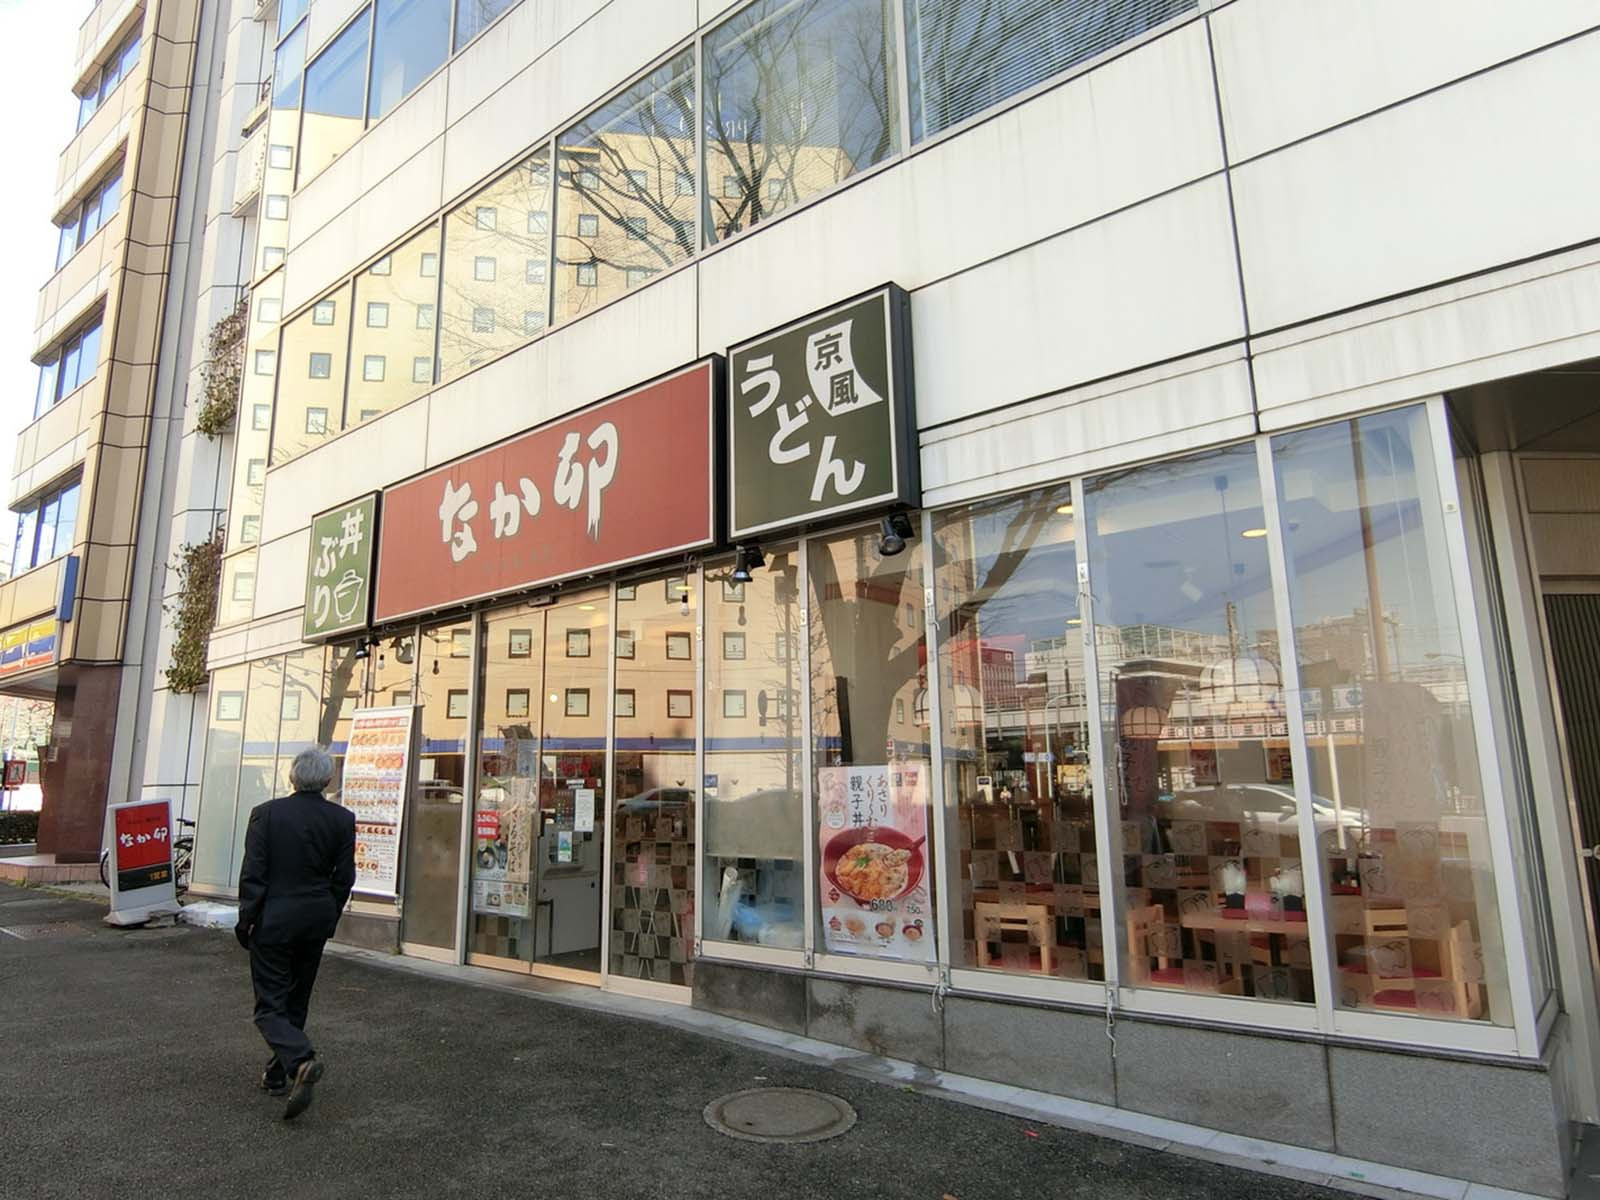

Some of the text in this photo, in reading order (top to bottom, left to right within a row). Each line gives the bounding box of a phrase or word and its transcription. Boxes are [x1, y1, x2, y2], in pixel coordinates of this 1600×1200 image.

[812, 331, 859, 412] 京風
[740, 353, 866, 502] うどん
[439, 421, 620, 564] なか卯
[878, 774, 889, 816] あさり
[119, 825, 169, 848] なか卯
